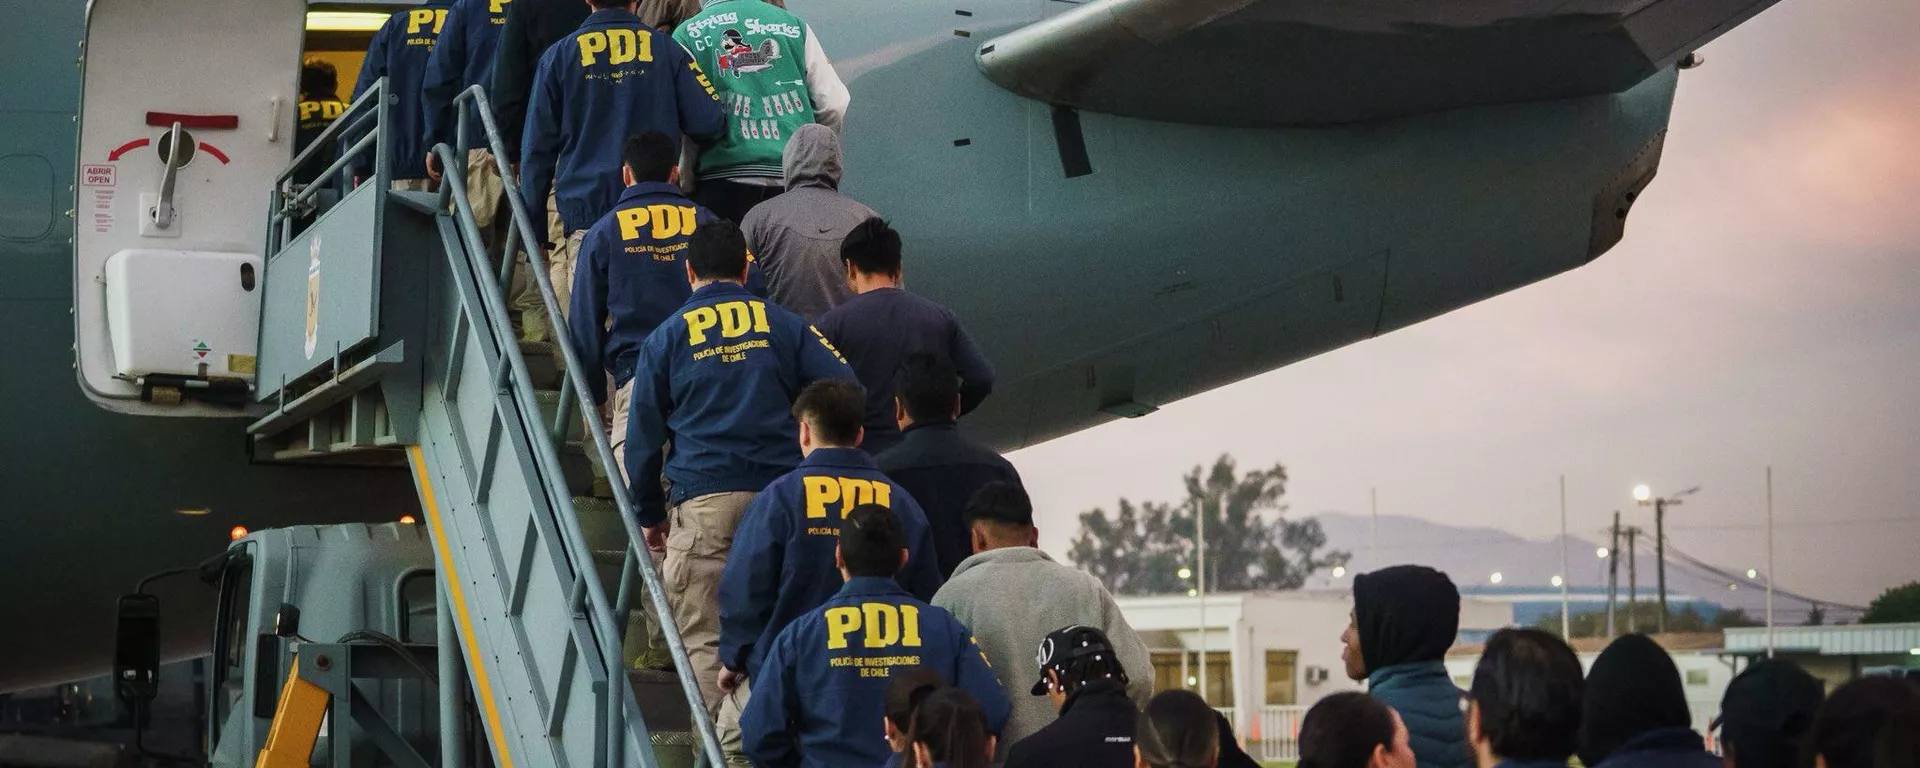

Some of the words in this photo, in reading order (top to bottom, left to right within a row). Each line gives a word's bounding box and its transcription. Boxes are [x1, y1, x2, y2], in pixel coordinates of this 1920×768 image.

[744, 18, 800, 38] Sharks
[576, 29, 653, 67] PDI
[299, 100, 350, 120] PD
[87, 167, 111, 175] ABRIR
[616, 204, 697, 240] PDI
[660, 253, 676, 261] CHILE
[682, 300, 770, 346] PDI
[693, 347, 716, 361] POLICÍA
[715, 345, 724, 354] DE
[722, 354, 730, 362] DE
[730, 351, 747, 362] CHILE
[803, 476, 891, 520] PDI
[808, 526, 832, 535] POLICÍA
[824, 602, 922, 650] PDI
[854, 657, 864, 666] DE
[864, 656, 920, 666] INVESTIGACIONES
[860, 667, 870, 677] DE
[871, 667, 890, 677] CHILE
